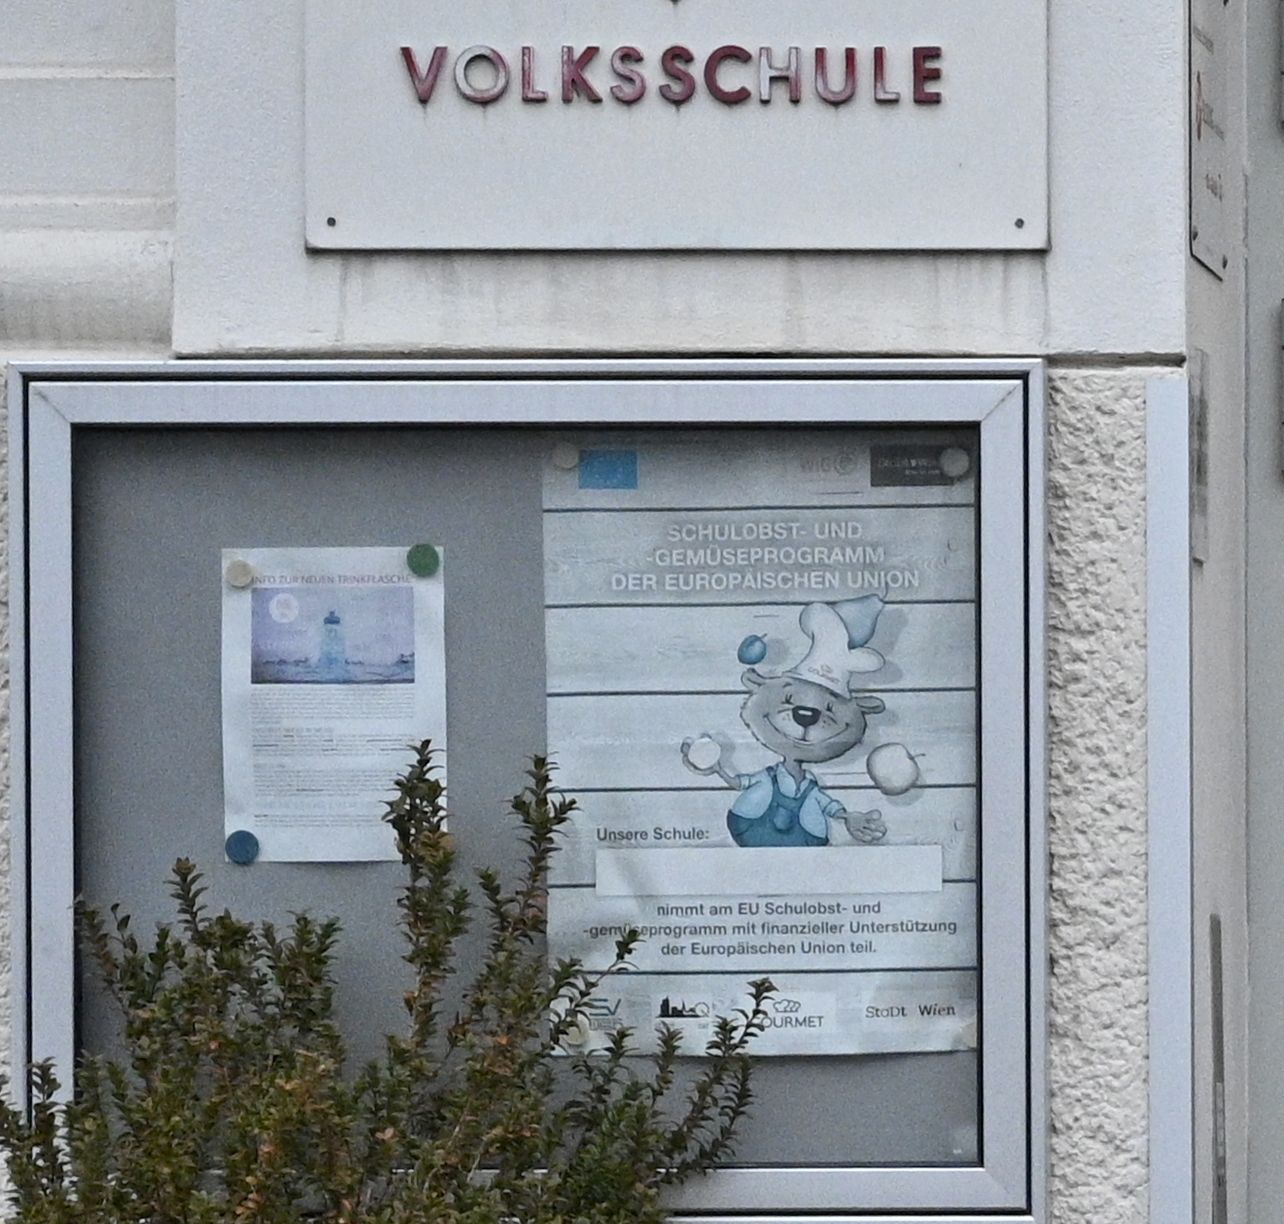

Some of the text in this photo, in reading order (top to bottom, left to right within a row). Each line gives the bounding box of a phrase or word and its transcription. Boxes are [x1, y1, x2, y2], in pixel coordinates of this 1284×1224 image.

[400, 45, 943, 106] VOLKSSCHULE
[667, 521, 863, 542] SCHULOBST- UND
[646, 545, 885, 567] -GEMÜSEPROGRAMM
[611, 568, 920, 591] DER EUROPÄISCHEN UNION
[596, 826, 710, 842] Unsere Schule:
[657, 901, 881, 916] nimmt am EU Schulobst- und
[732, 921, 756, 935] mit
[761, 920, 845, 935] finanzieller
[850, 920, 957, 935] Unterstützung
[661, 940, 877, 958] der Europäischen Union teil.
[918, 1003, 956, 1016] Wien
[757, 1015, 824, 1029] OURMET
